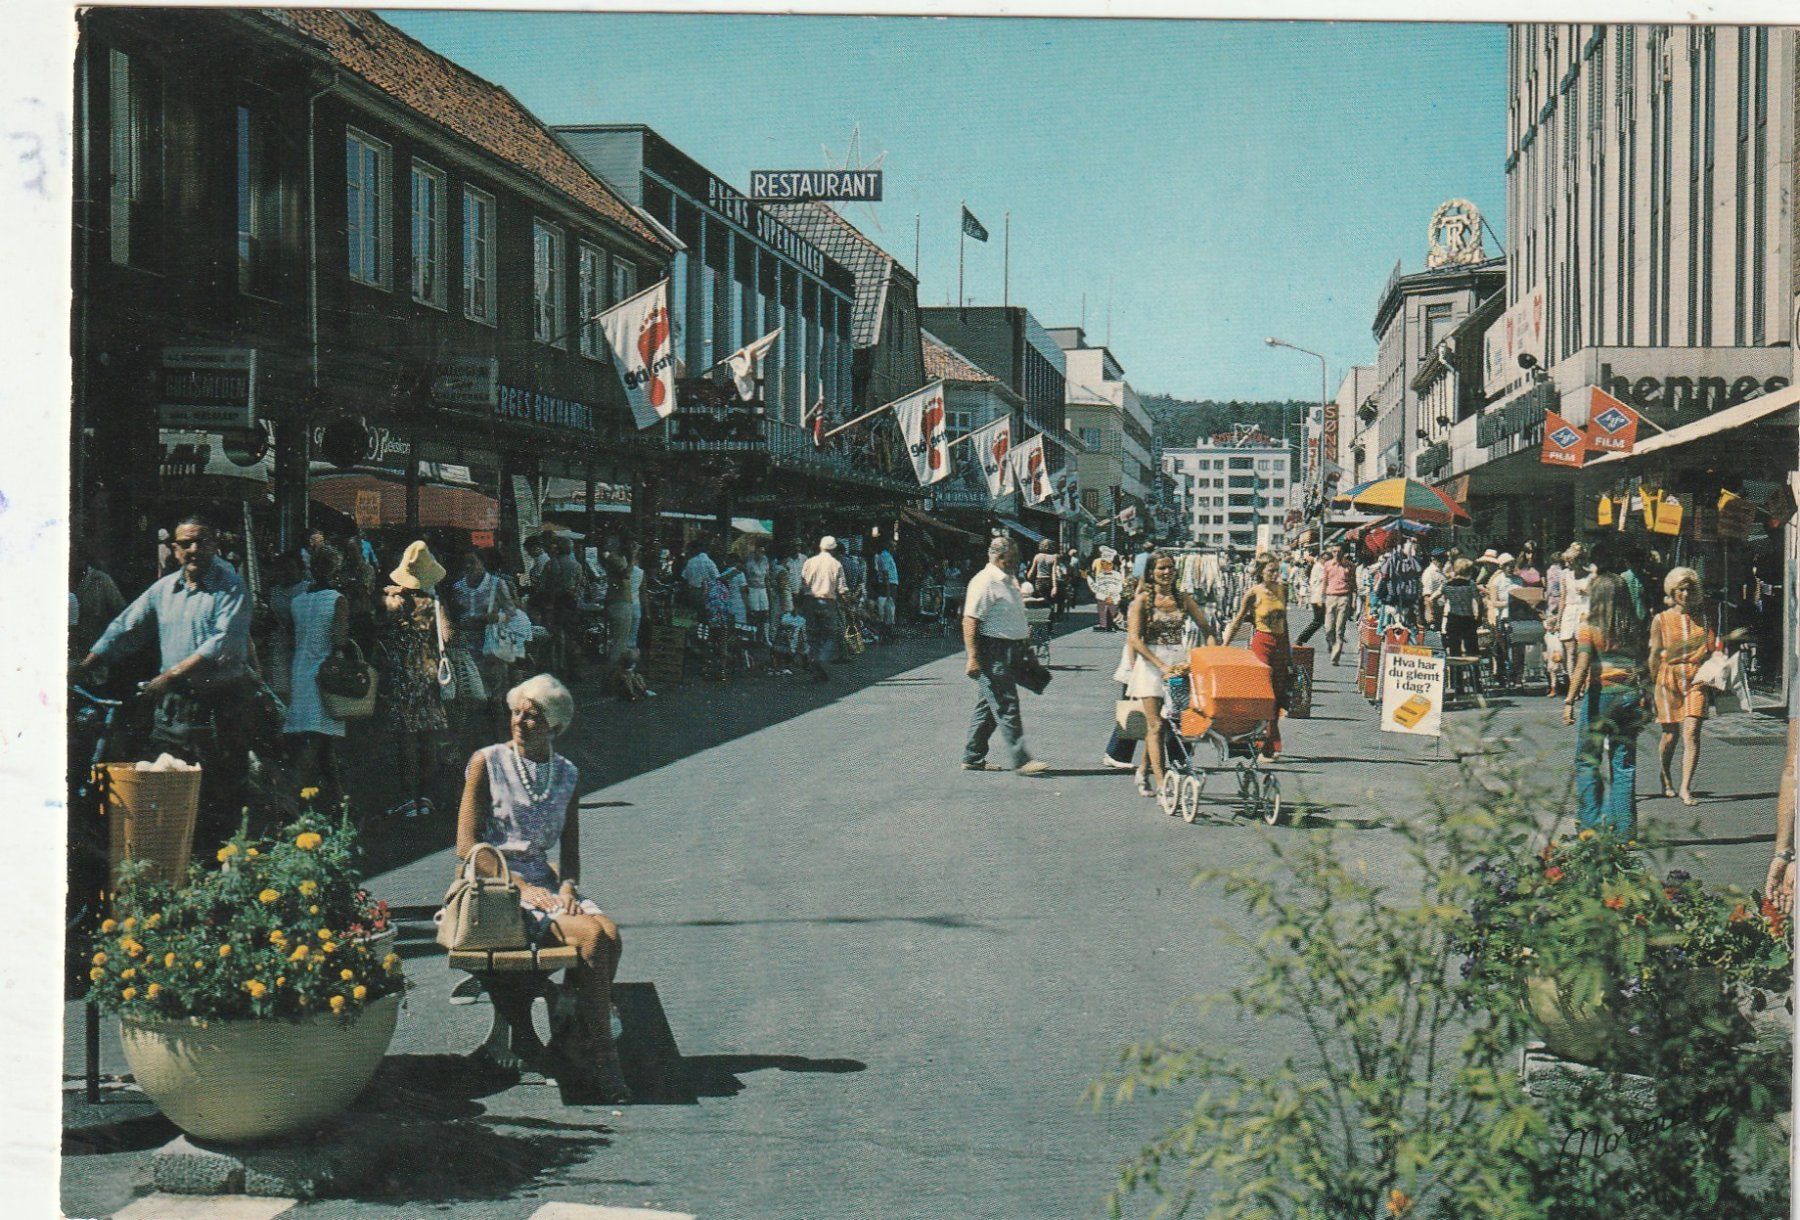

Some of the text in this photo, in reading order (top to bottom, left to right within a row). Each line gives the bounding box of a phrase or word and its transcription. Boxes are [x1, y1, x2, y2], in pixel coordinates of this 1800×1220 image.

[754, 173, 878, 197] RESTAURANT
[709, 177, 749, 229] BYENS
[1601, 363, 1789, 410] hennes
[1594, 437, 1626, 449] FILM
[1549, 451, 1576, 462] FILM
[1393, 656, 1437, 670] Hva har
[1389, 668, 1440, 682] du glemt
[1402, 681, 1431, 694] dag?
